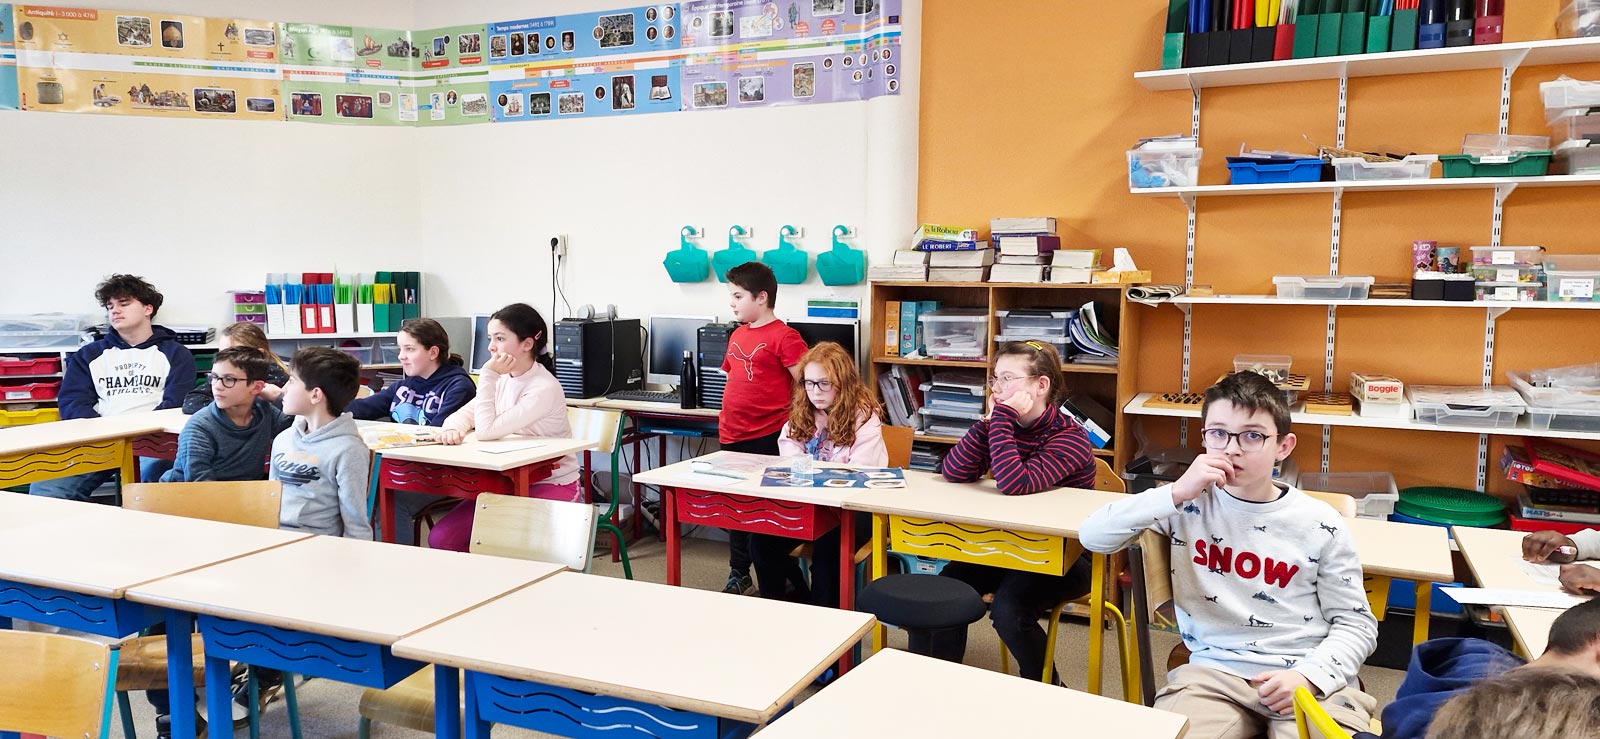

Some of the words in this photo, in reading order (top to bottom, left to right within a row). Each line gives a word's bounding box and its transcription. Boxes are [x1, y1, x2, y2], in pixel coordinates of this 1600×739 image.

[98, 374, 162, 389] CHAMPION
[1368, 385, 1399, 394] Boggle
[1193, 539, 1300, 589] SNOW
